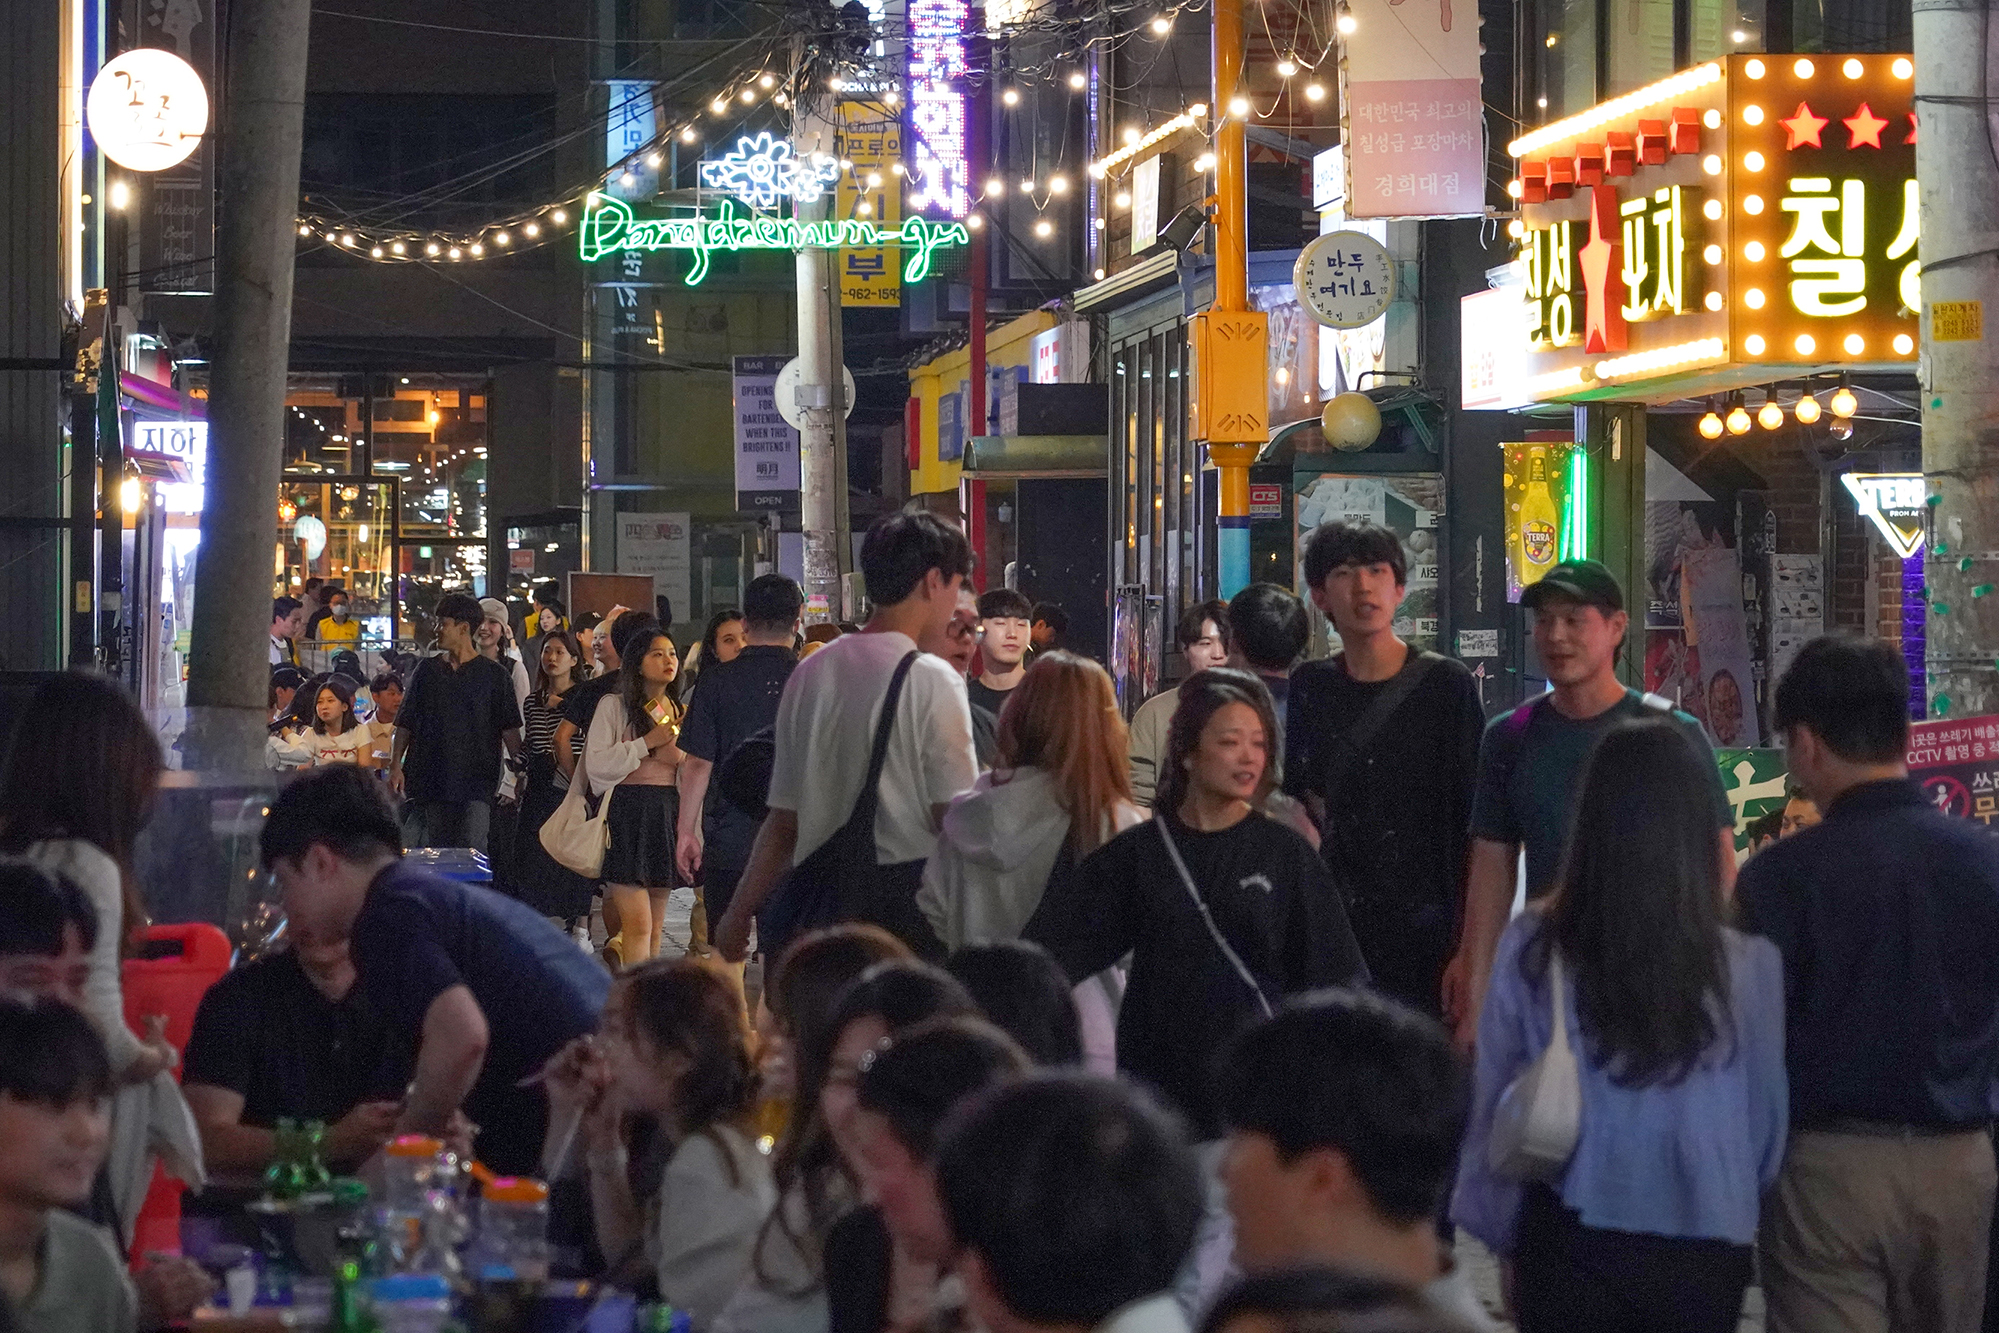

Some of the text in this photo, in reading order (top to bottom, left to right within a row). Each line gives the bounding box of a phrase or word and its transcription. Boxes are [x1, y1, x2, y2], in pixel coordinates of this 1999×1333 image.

[1358, 100, 1472, 123] 대한민국 최고의
[1360, 131, 1474, 154] 칠성급 포장마차
[1375, 172, 1459, 197] 경희대점
[1620, 184, 1685, 322] 포차
[1327, 249, 1364, 276] 만두
[1320, 277, 1376, 298] 여기요
[743, 361, 763, 370] BAR
[758, 400, 773, 410] FOR
[745, 427, 787, 439] WHEN THIS
[754, 496, 782, 505] OPEN
[1252, 491, 1278, 501] CTS
[1527, 532, 1550, 542] TERRA
[1939, 728, 1972, 743] 쓰레기
[1906, 748, 1941, 764] CCTV
[1945, 744, 1970, 761] 촬영
[1972, 742, 1986, 757] 중
